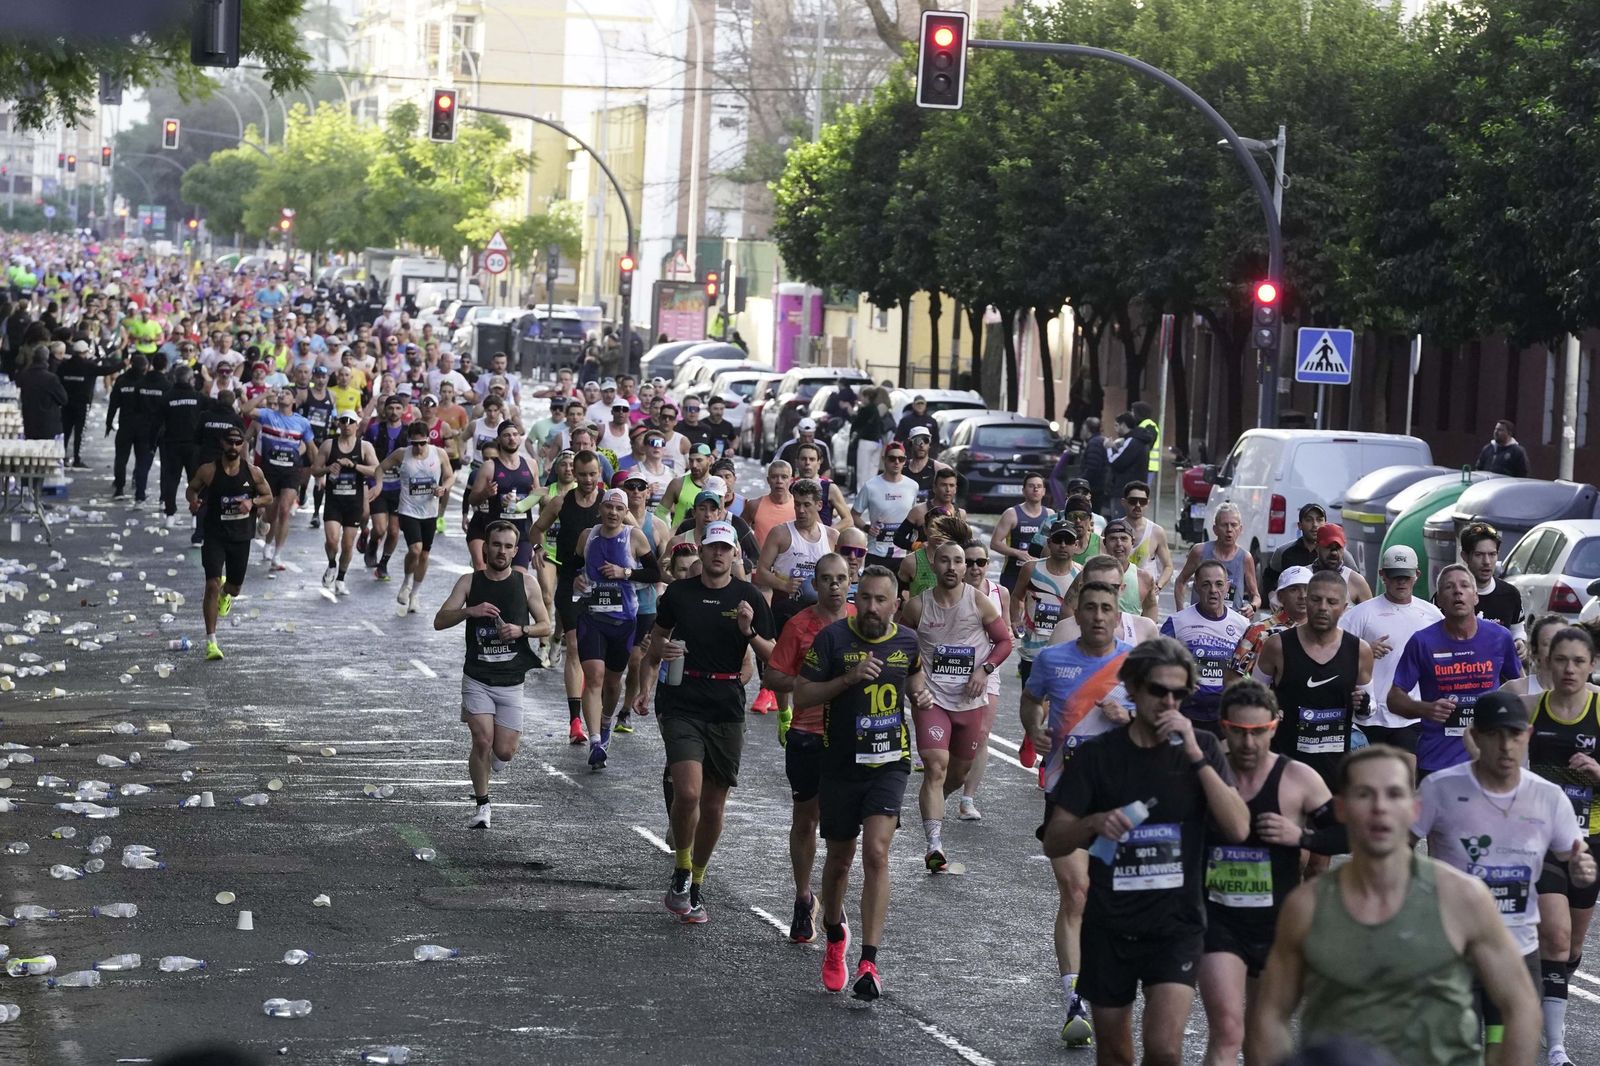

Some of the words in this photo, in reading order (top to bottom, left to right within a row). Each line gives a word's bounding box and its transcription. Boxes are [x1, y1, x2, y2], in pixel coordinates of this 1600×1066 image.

[490, 258, 503, 267] 30
[140, 388, 163, 396] VOLUNTEER
[169, 398, 198, 407] VOLUNTEER
[598, 597, 611, 605] FER
[483, 644, 512, 654] MIGUEL
[1191, 638, 1235, 650] CAMARMA
[844, 654, 859, 662] grn
[934, 665, 972, 675] JAVIHDEZ
[1201, 668, 1223, 678] CANO
[1434, 660, 1494, 676] Run2Forty2
[1454, 682, 1480, 690] Marathon
[863, 683, 898, 714] 10
[1316, 711, 1342, 719] ZURICH
[874, 717, 897, 727] ZURICH
[874, 732, 888, 740] 5042
[1297, 735, 1320, 744] SERGIO
[1320, 734, 1345, 743] JIMENEZ
[871, 741, 891, 752] TONI
[1132, 827, 1173, 839] ZURICH
[1226, 850, 1264, 860] ZURICH
[1113, 866, 1138, 877] ALEX
[1138, 861, 1184, 876] RUNWISE
[1491, 870, 1525, 879] ZURICH
